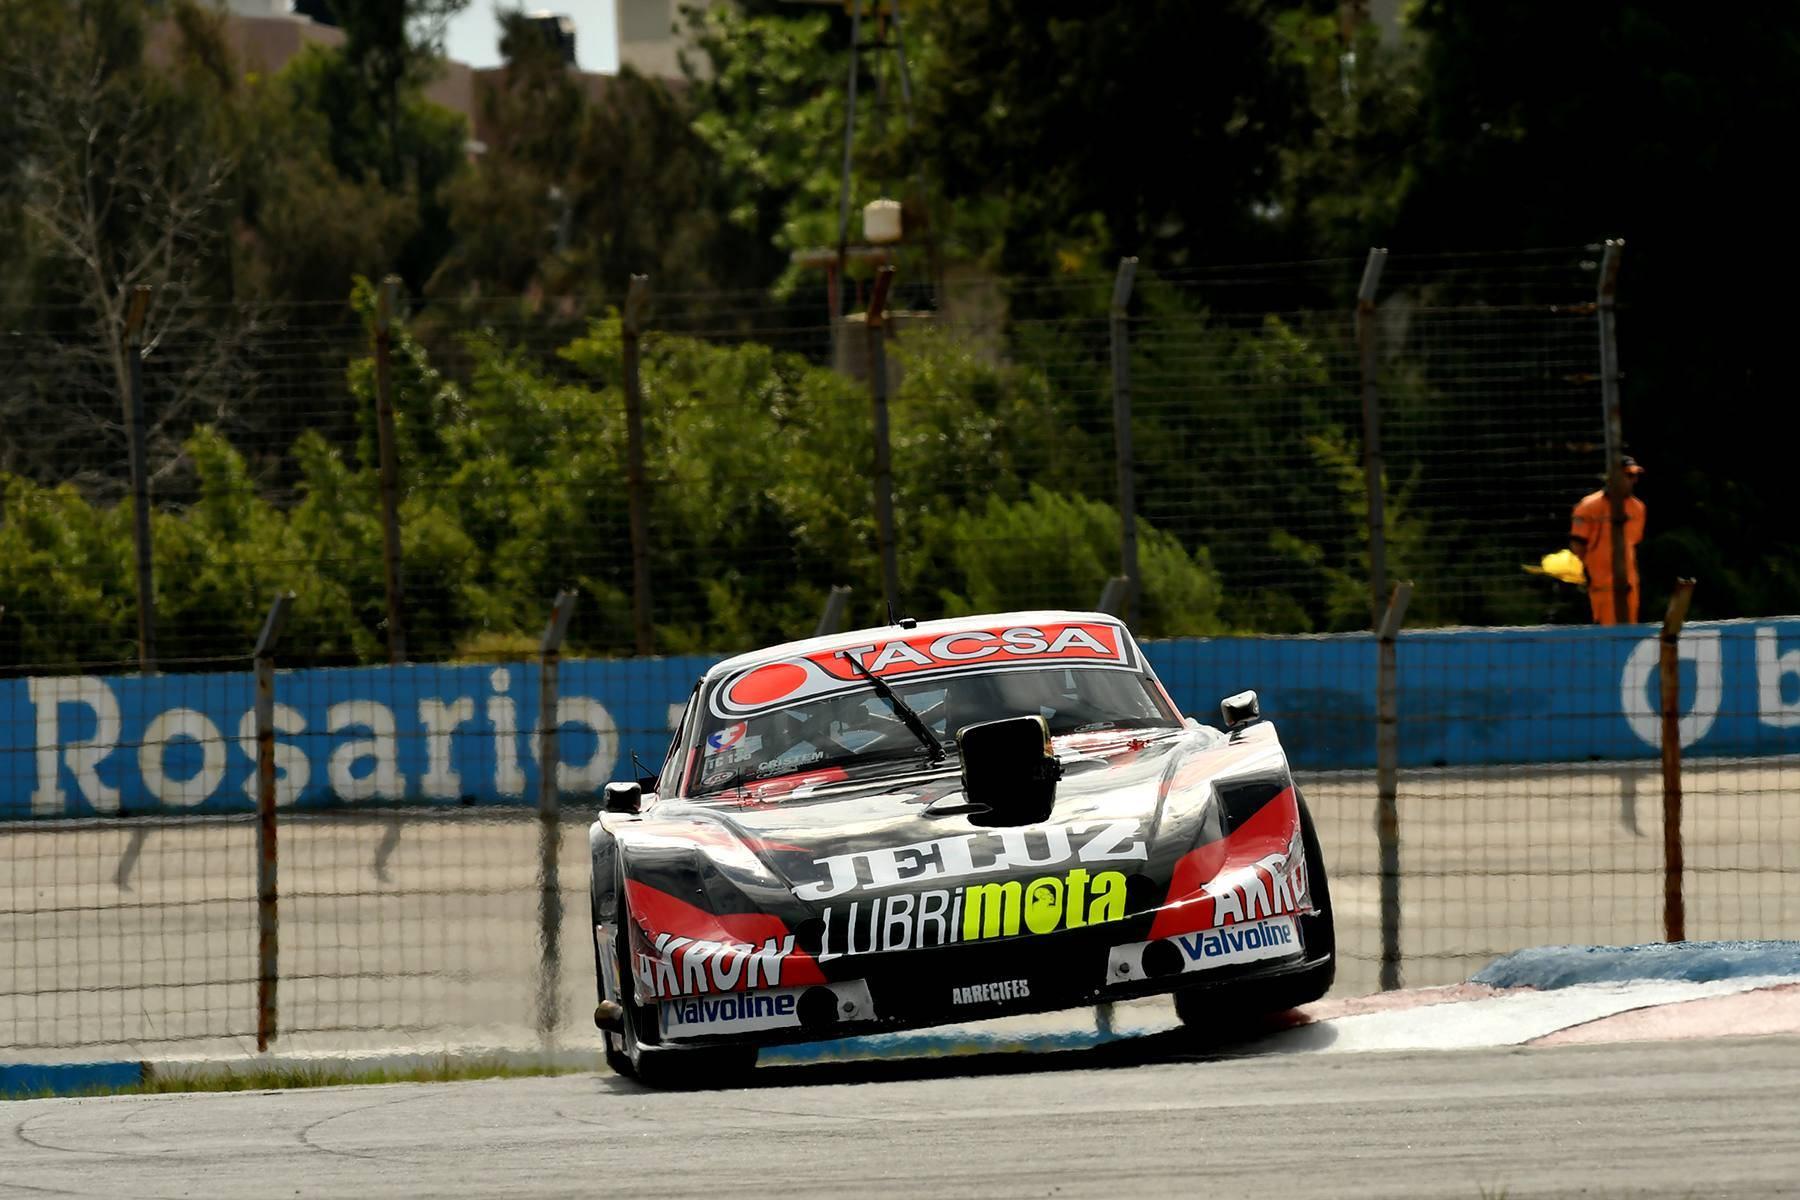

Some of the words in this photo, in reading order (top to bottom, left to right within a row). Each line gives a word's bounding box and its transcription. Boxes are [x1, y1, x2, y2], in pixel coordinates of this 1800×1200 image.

[834, 627, 1113, 676] TACSA
[28, 667, 619, 815] Rosario
[791, 818, 1149, 901] JELUZ
[638, 932, 796, 998] AKRON
[1180, 920, 1292, 962] Valvoline
[672, 993, 796, 1025] Valvoline
[952, 979, 1031, 1005] ARRECIFES
